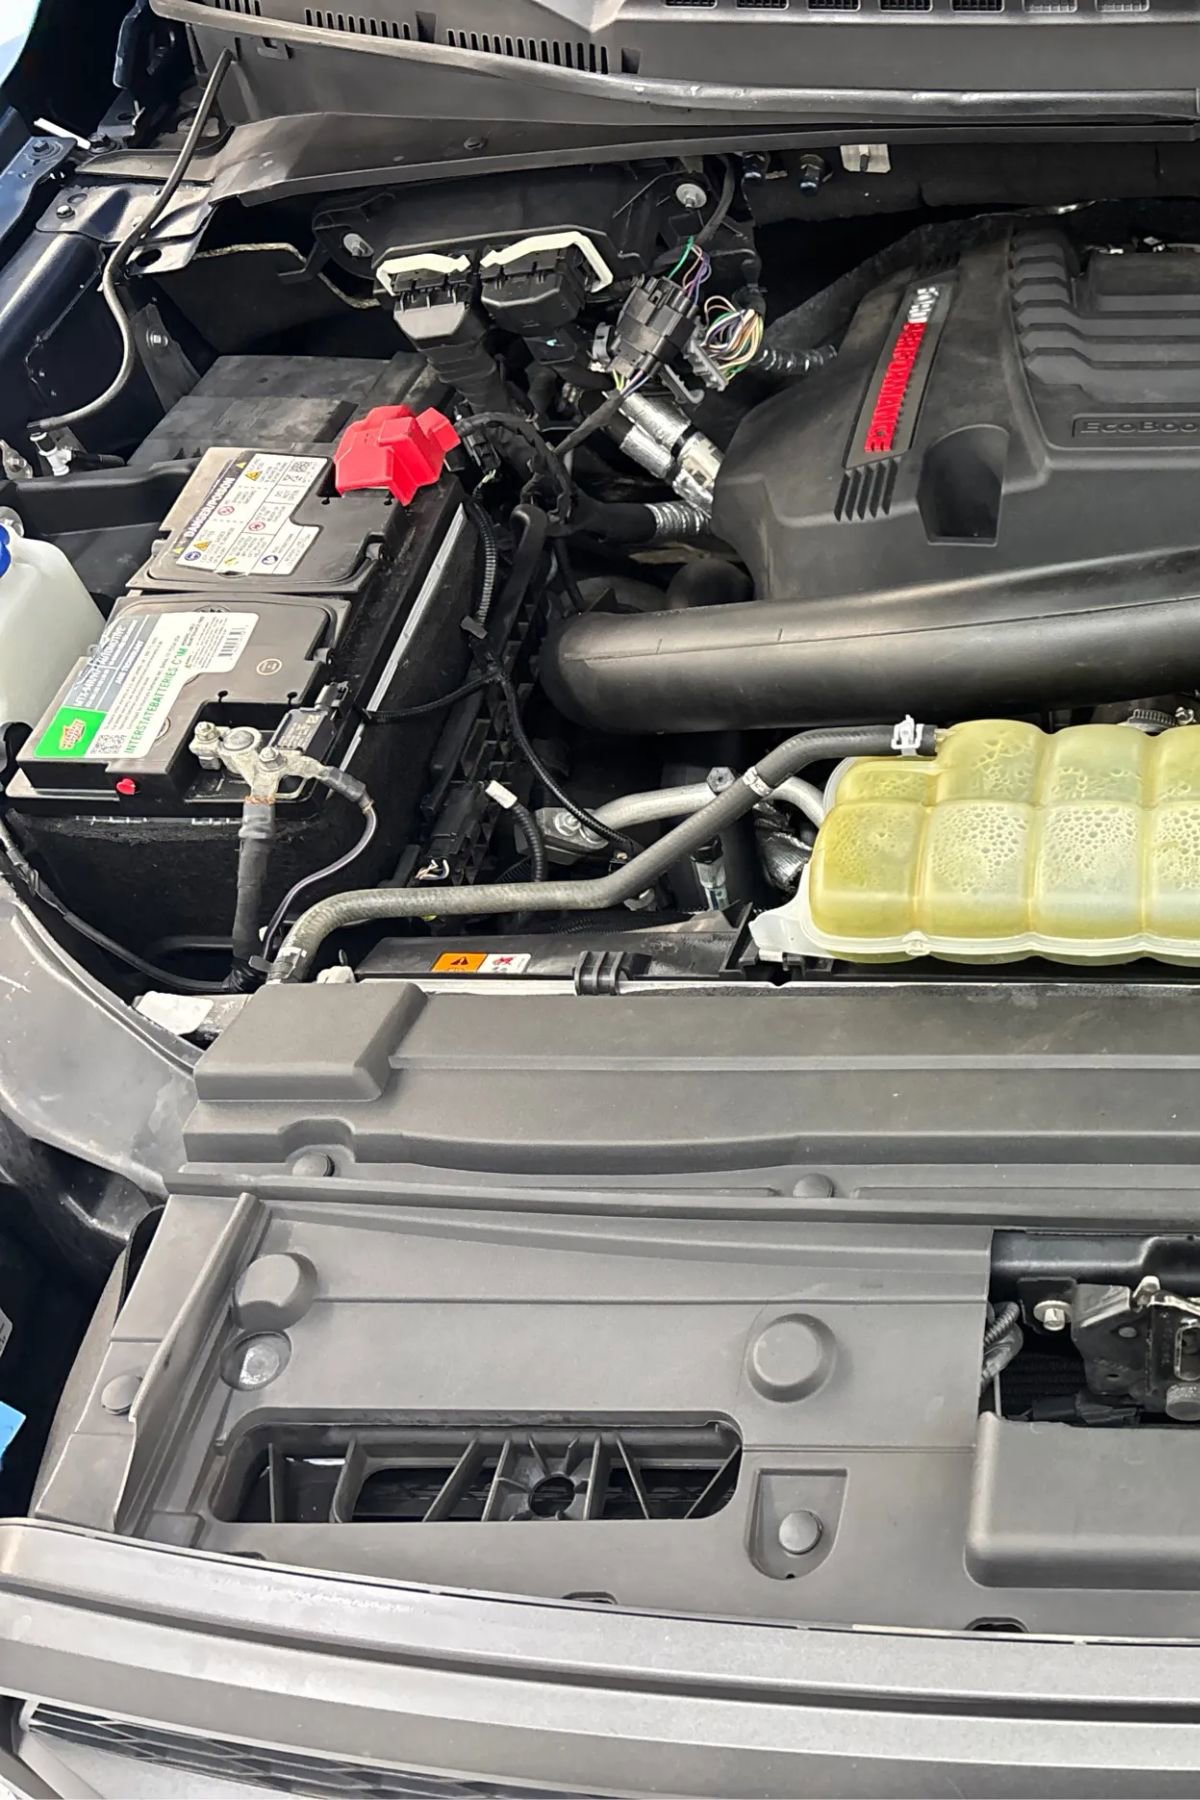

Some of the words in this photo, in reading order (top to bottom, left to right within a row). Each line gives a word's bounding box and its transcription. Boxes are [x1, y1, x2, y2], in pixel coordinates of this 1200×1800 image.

[907, 286, 939, 323] FORD
[864, 322, 927, 452] PERFORMANCE
[183, 476, 236, 539] DANGER/POISON
